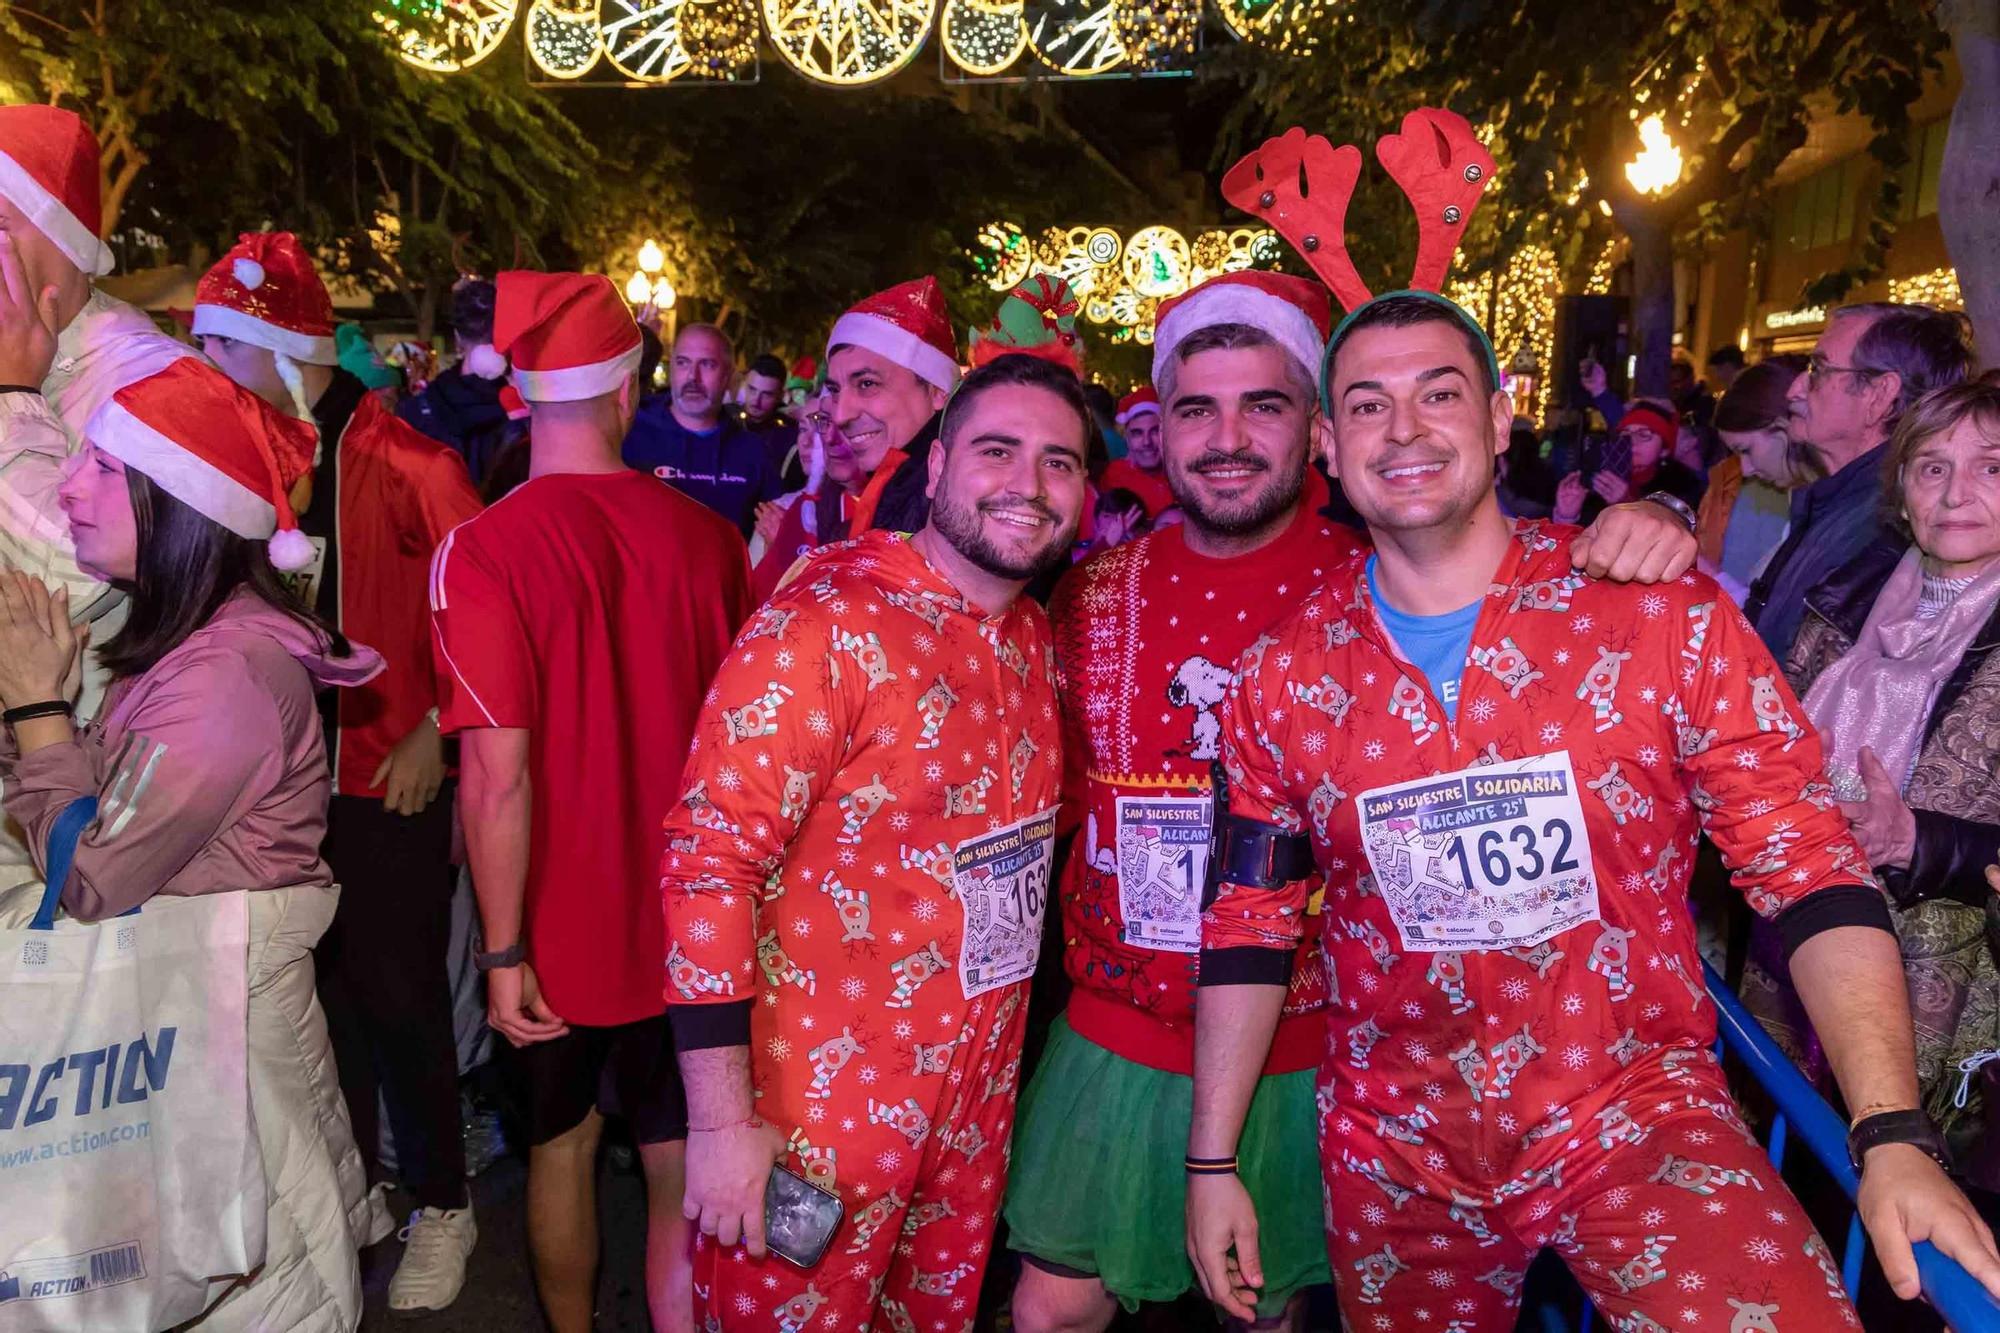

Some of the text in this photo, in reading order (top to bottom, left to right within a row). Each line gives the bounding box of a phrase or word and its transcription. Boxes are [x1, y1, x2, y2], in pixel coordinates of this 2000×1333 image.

[1367, 776, 1563, 817] SAN SILVESTRE SOLIDARIA
[1124, 808, 1201, 821] SAN SILVESTRE
[1420, 804, 1497, 831] ALICANTE
[1162, 829, 1208, 841] ALICAN
[955, 851, 974, 868] SAN
[976, 834, 1020, 859] SILVESTRE
[994, 848, 1032, 877] ALICANTE
[1447, 818, 1579, 890] 1632
[0, 1121, 152, 1169] ww.action.com
